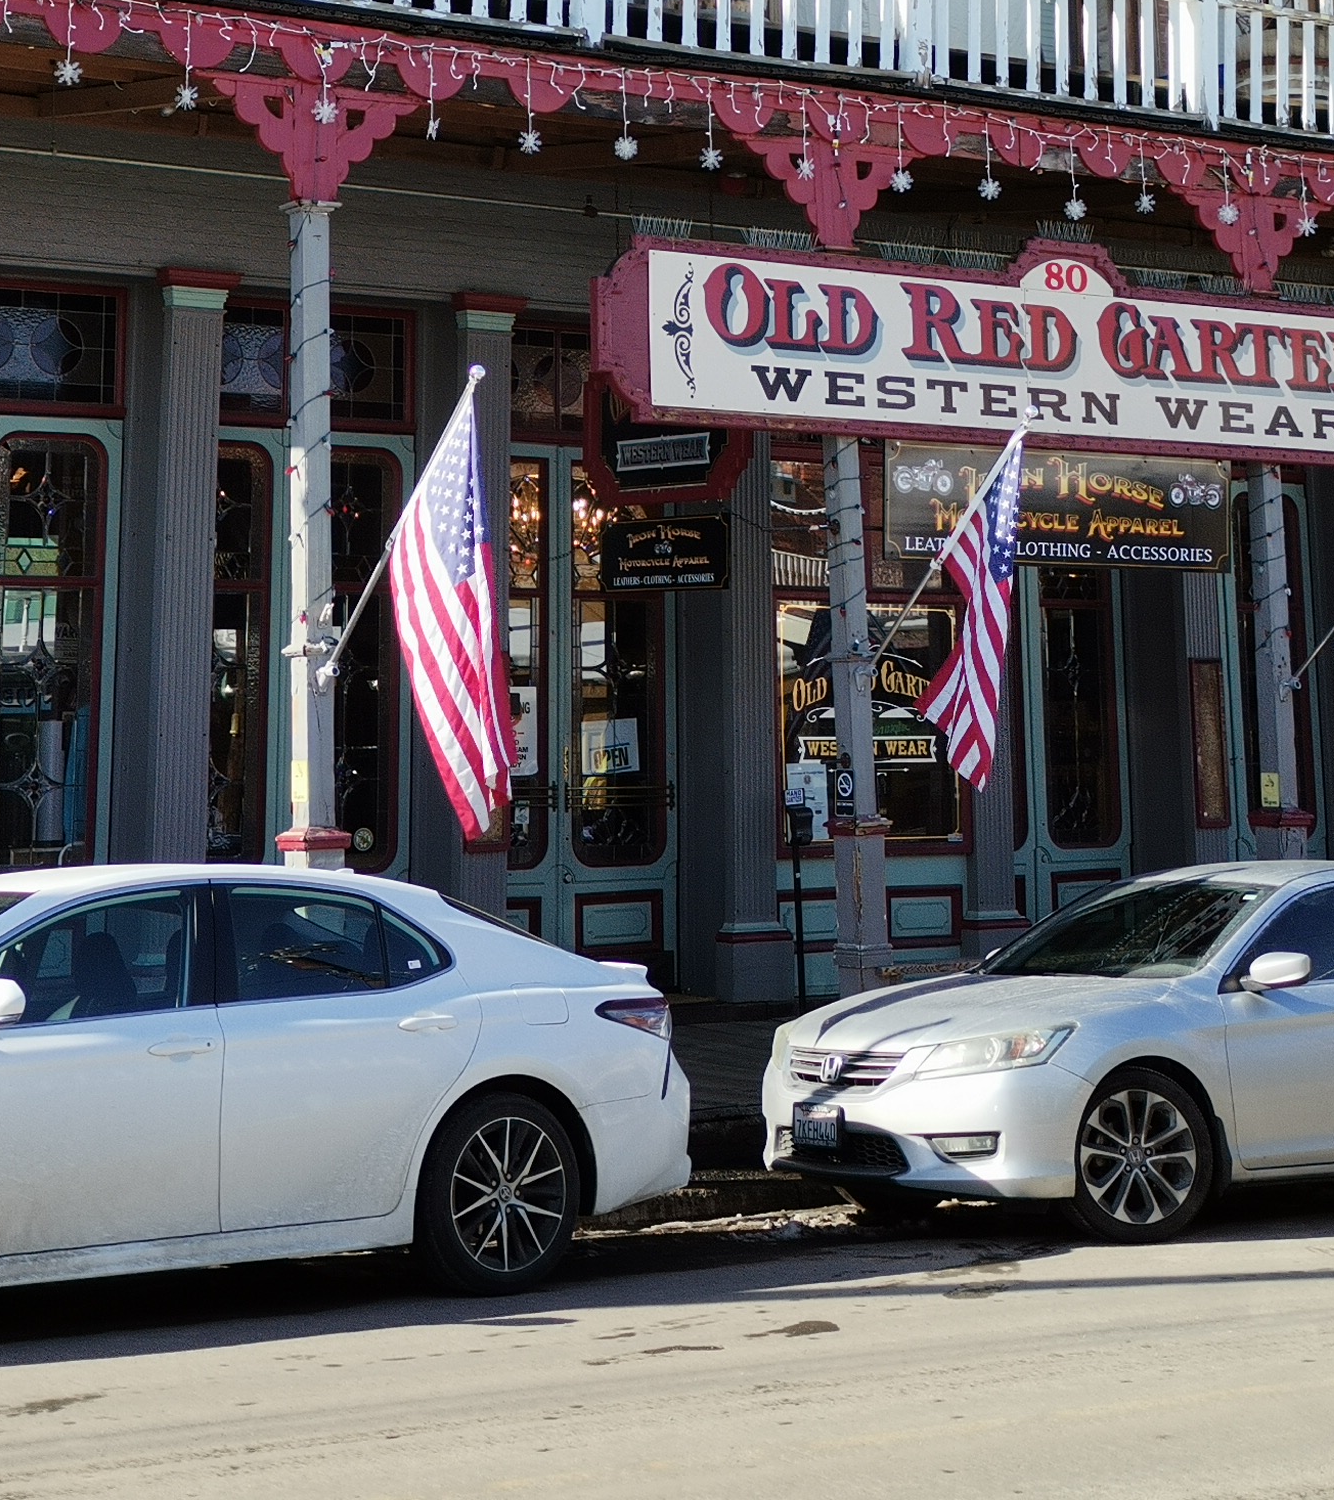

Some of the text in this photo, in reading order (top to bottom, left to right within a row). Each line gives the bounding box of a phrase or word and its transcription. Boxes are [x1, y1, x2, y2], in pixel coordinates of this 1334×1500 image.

[1045, 263, 1088, 292] 80
[703, 262, 882, 358] OLD
[900, 281, 1079, 373] RED
[751, 365, 1120, 426] WESTERN
[621, 438, 705, 466] WESTERN WEAR
[1048, 456, 1165, 510] HORSE
[626, 524, 702, 548] IRON HORSE
[1088, 508, 1186, 540] APPAREL
[618, 555, 710, 572] MOTORCYCLE APPAREL
[1016, 541, 1092, 558] LOTHING
[1107, 544, 1213, 563] ACCESSORIES
[793, 677, 828, 711] OLD
[593, 748, 629, 770] OPEN
[885, 740, 928, 756] WEAR
